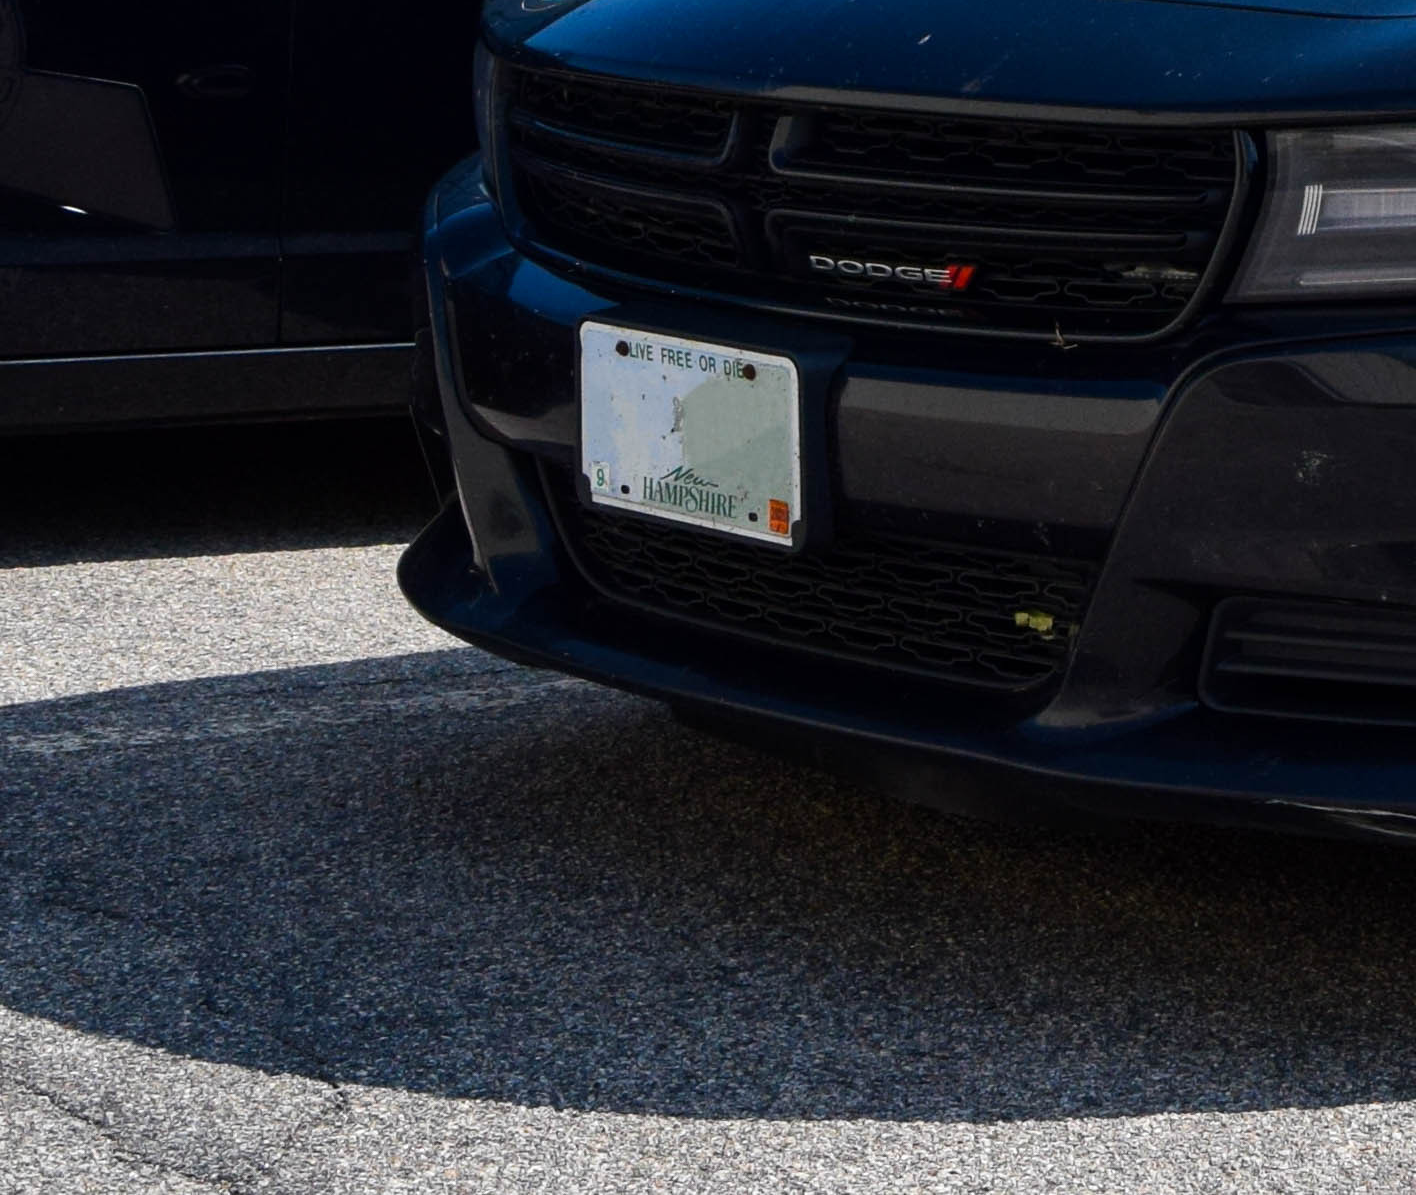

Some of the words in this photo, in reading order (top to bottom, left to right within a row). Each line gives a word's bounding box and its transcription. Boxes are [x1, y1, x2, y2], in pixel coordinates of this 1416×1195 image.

[809, 255, 952, 283] DODGE
[629, 341, 654, 362] LIVE
[660, 347, 693, 369] FREE
[699, 355, 717, 374] OR
[723, 359, 745, 379] DIE
[596, 468, 606, 487] 9
[660, 465, 719, 488] New
[643, 476, 737, 520] HAMPSHIRE
